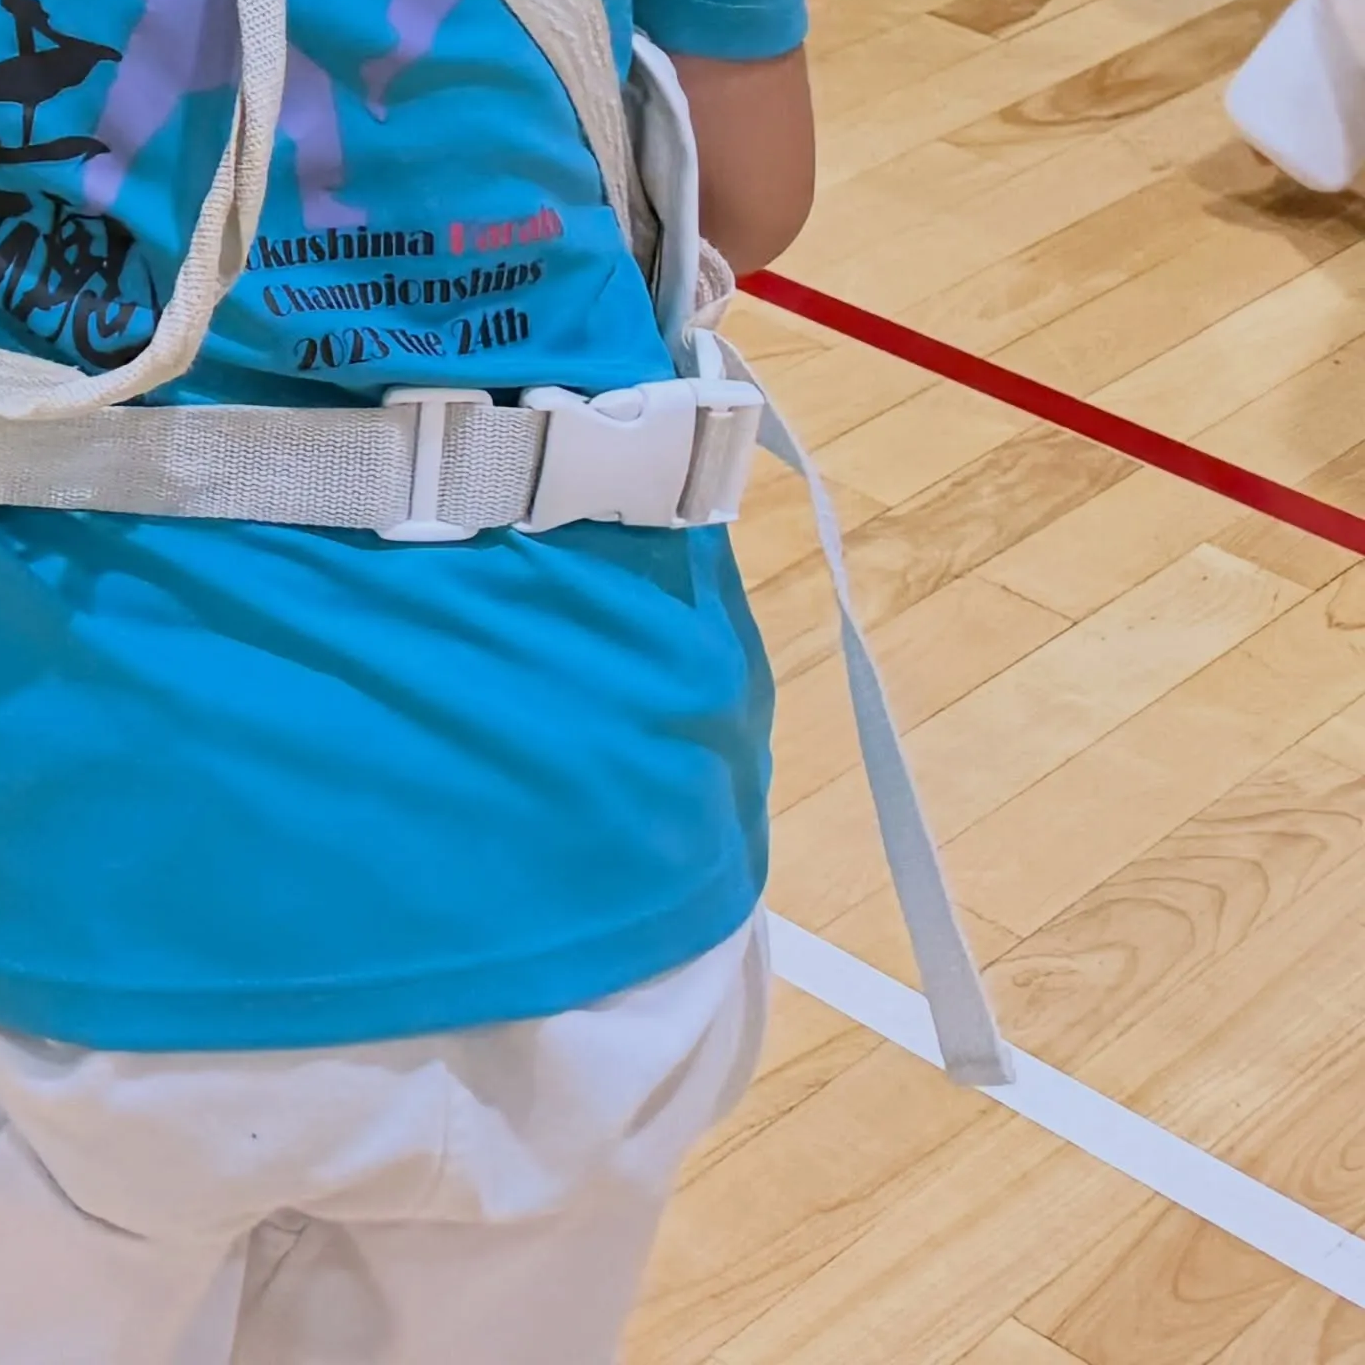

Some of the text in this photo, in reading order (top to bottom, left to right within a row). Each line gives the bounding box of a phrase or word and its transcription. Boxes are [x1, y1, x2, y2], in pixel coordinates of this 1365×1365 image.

[262, 257, 546, 317] Championships
[293, 326, 390, 371] 2023
[451, 306, 531, 357] 24th
